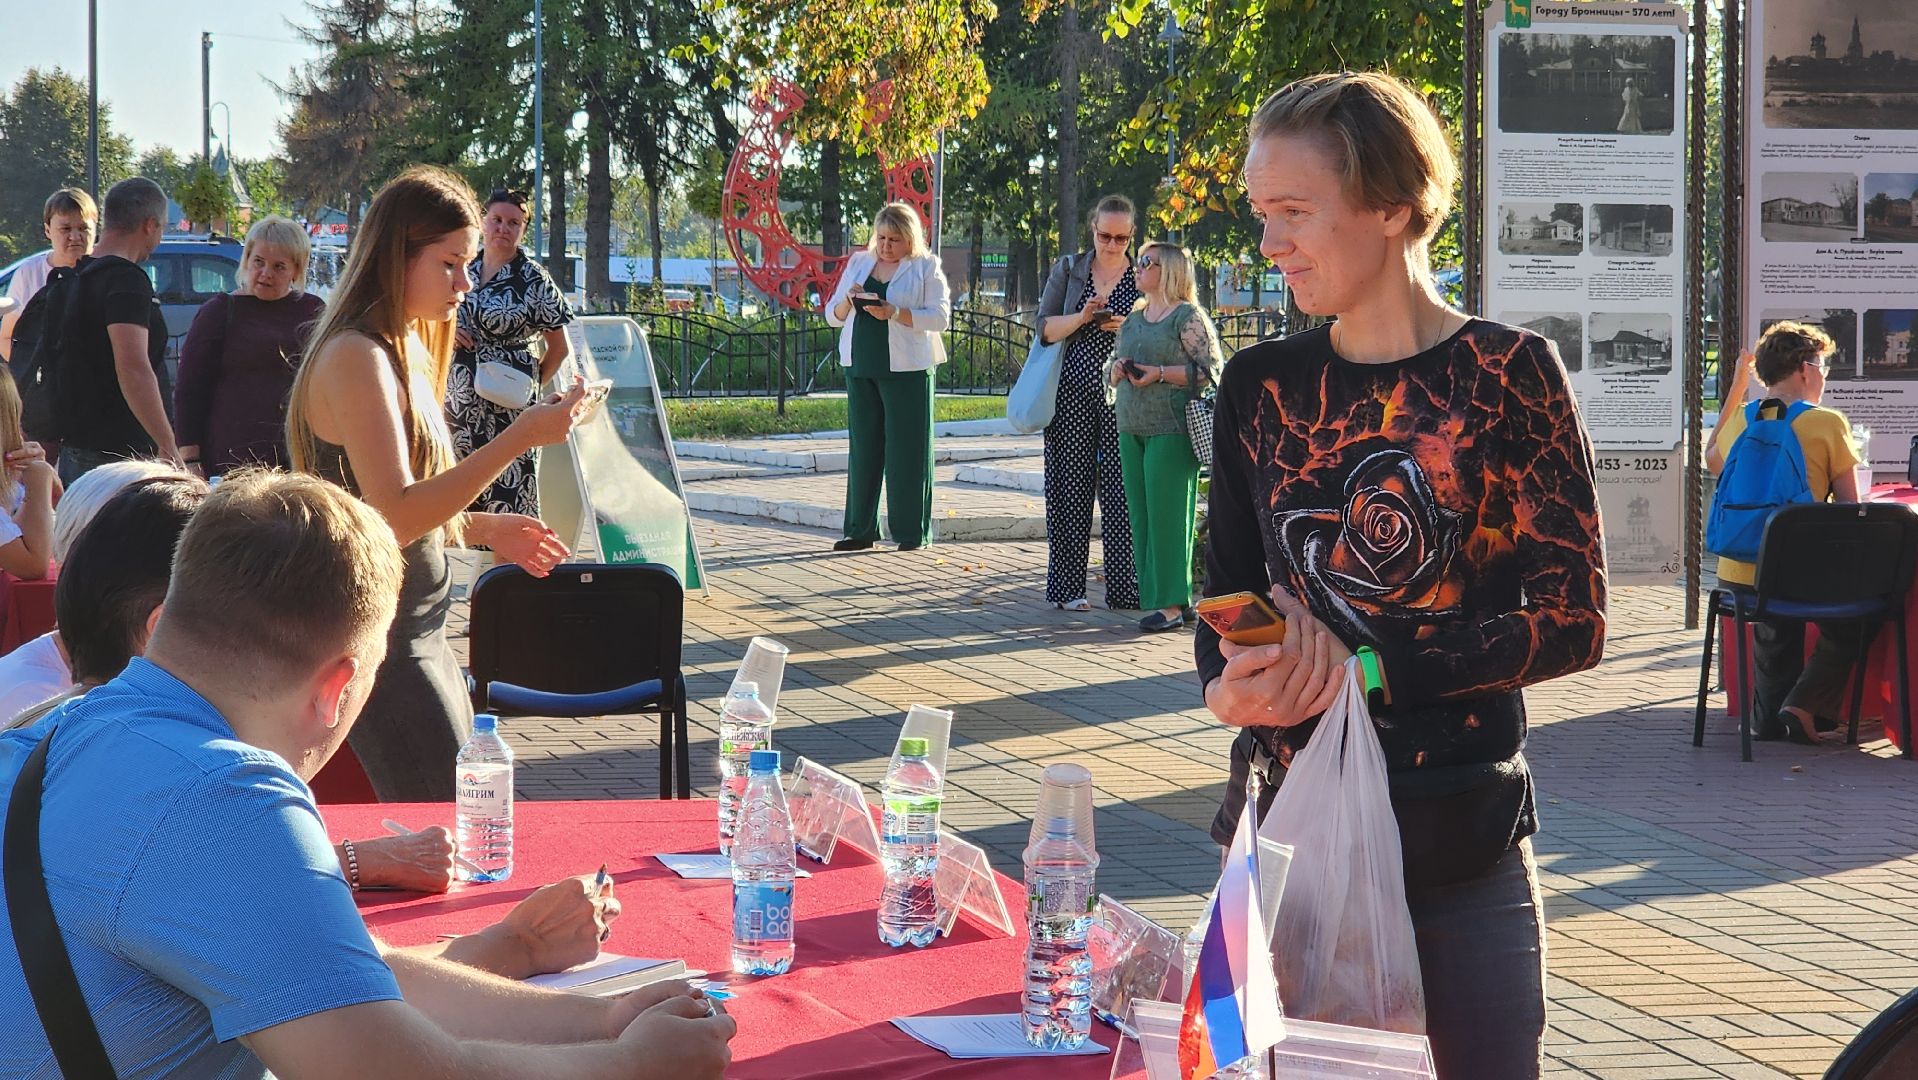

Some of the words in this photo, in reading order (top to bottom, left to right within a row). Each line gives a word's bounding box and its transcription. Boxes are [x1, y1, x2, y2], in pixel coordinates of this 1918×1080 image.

[1535, 6, 1569, 18] Городу
[1571, 6, 1623, 17] Бронницы
[1632, 9, 1650, 17] 570
[1652, 9, 1676, 18] лет!
[1595, 458, 1620, 471] 453
[1634, 458, 1668, 471] 2023
[624, 531, 673, 545] ВЫЕЗДНАЯ
